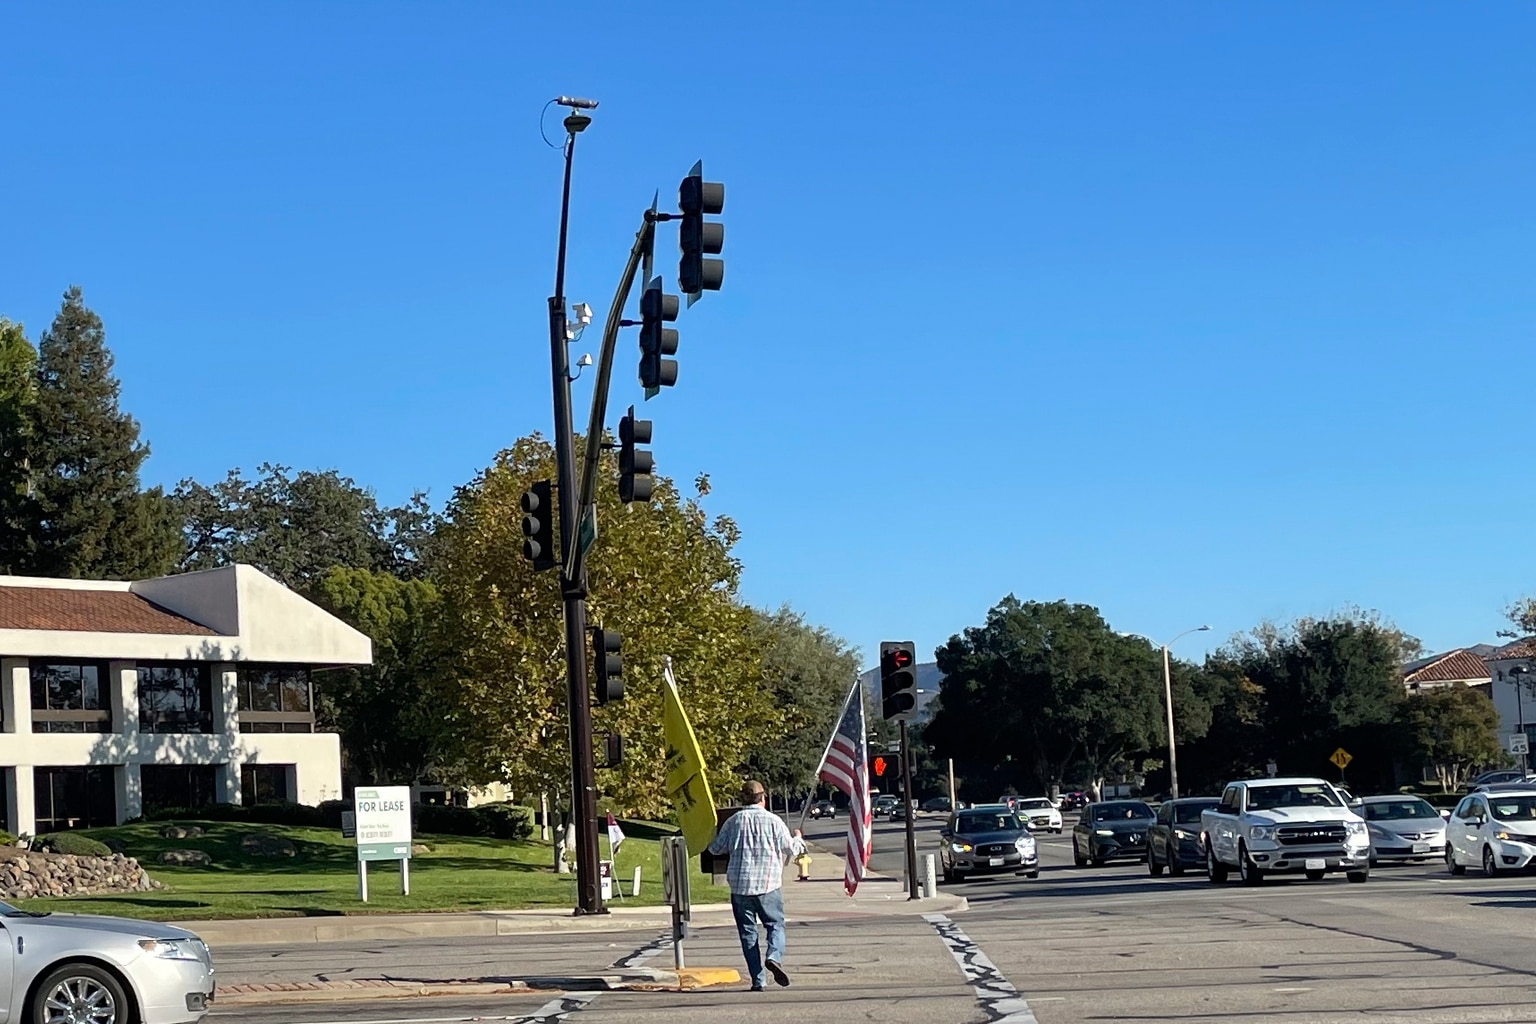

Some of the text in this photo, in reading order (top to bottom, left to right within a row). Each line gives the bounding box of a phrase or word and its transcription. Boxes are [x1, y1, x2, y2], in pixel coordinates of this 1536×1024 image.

[1511, 744, 1528, 753] 45
[358, 801, 404, 812] FOR LEASE
